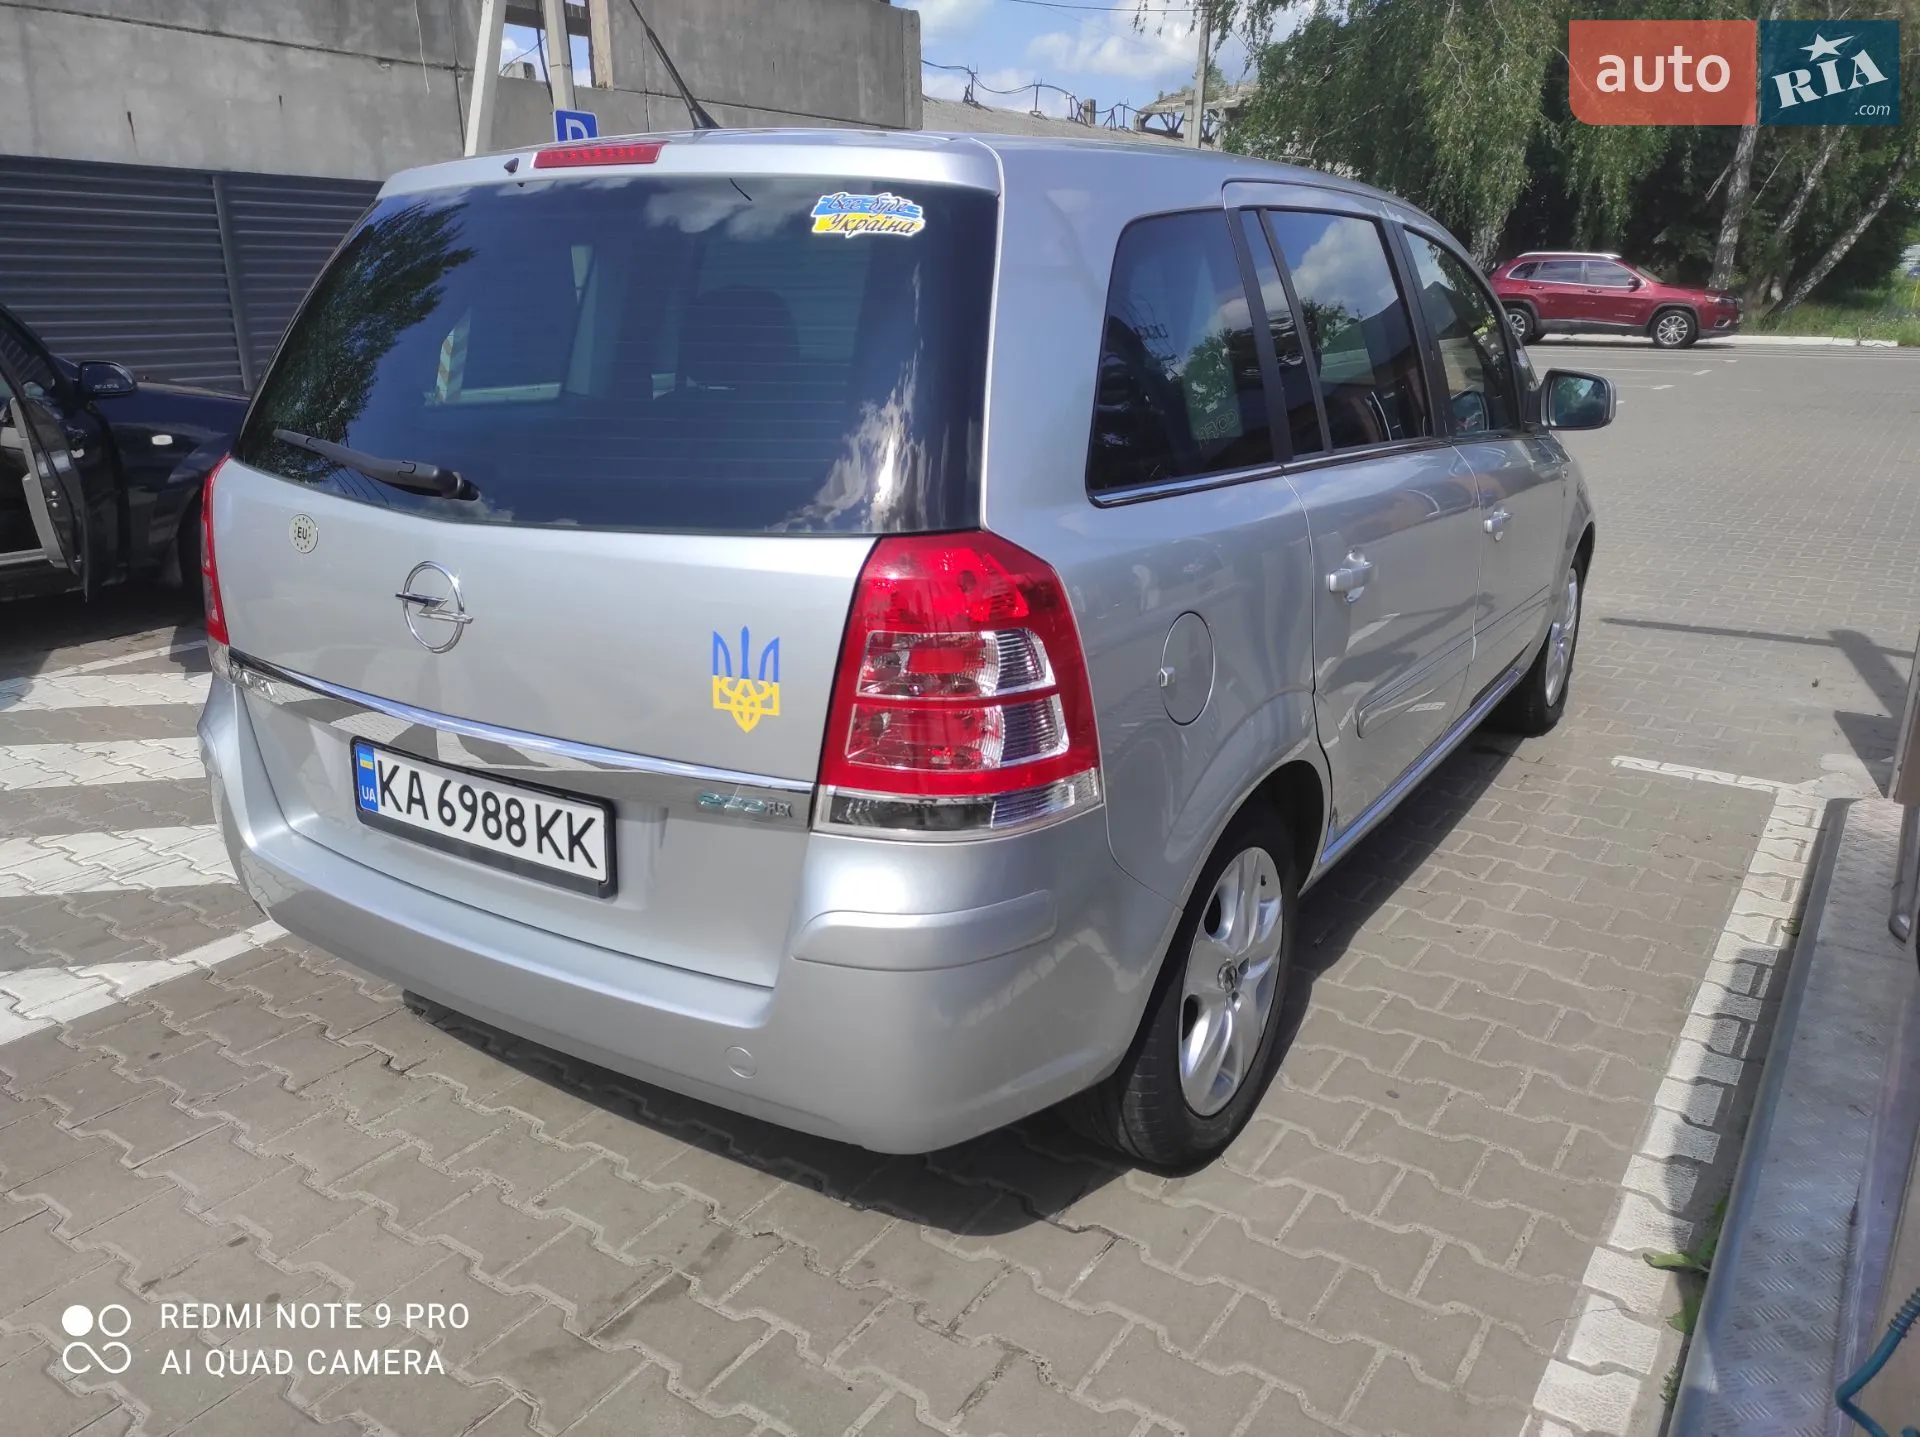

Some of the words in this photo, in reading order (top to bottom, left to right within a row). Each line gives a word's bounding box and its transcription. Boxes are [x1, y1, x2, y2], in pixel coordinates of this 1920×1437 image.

[826, 213, 915, 236] Україна
[297, 526, 308, 540] EU
[361, 785, 376, 803] UA
[438, 779, 527, 848] 6988
